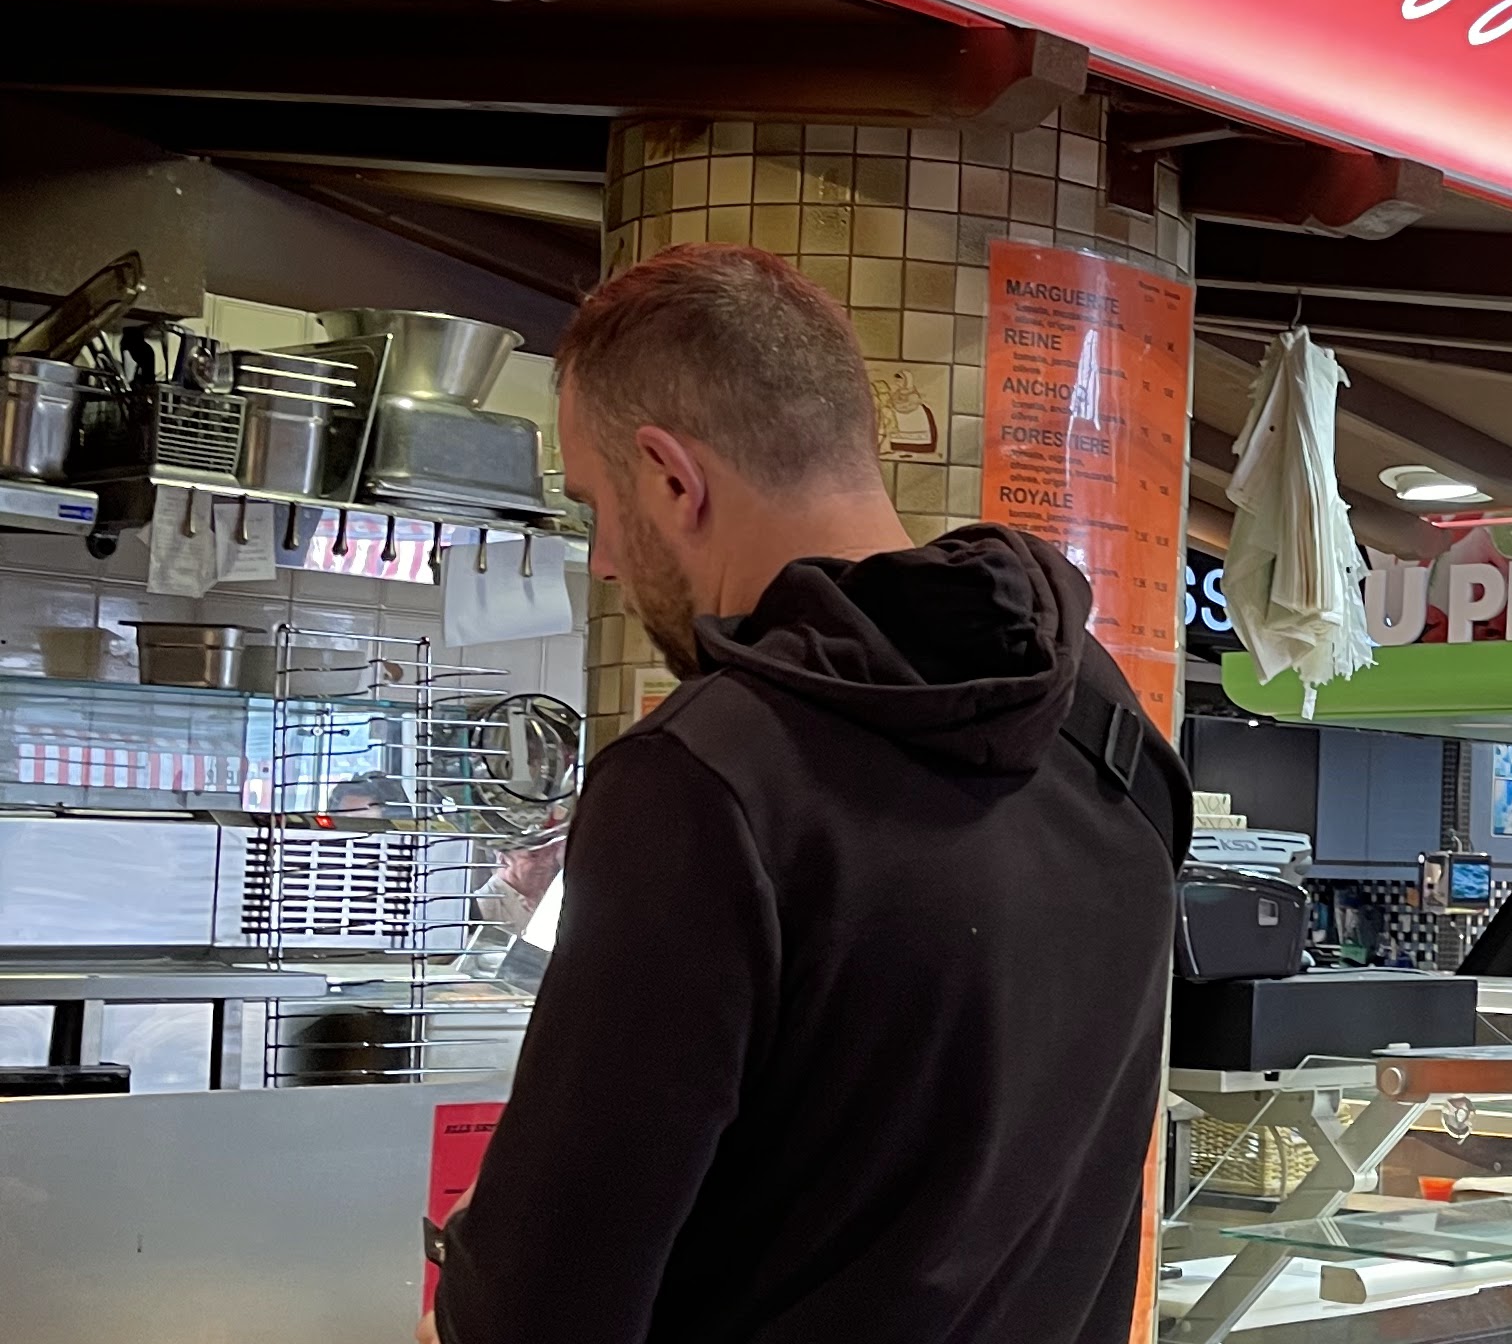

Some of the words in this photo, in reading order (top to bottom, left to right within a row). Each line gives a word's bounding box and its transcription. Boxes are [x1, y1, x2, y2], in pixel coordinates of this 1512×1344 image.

[1004, 327, 1062, 351] REINE
[1001, 425, 1110, 456] FORESTIERE
[1000, 485, 1073, 509] ROYALE
